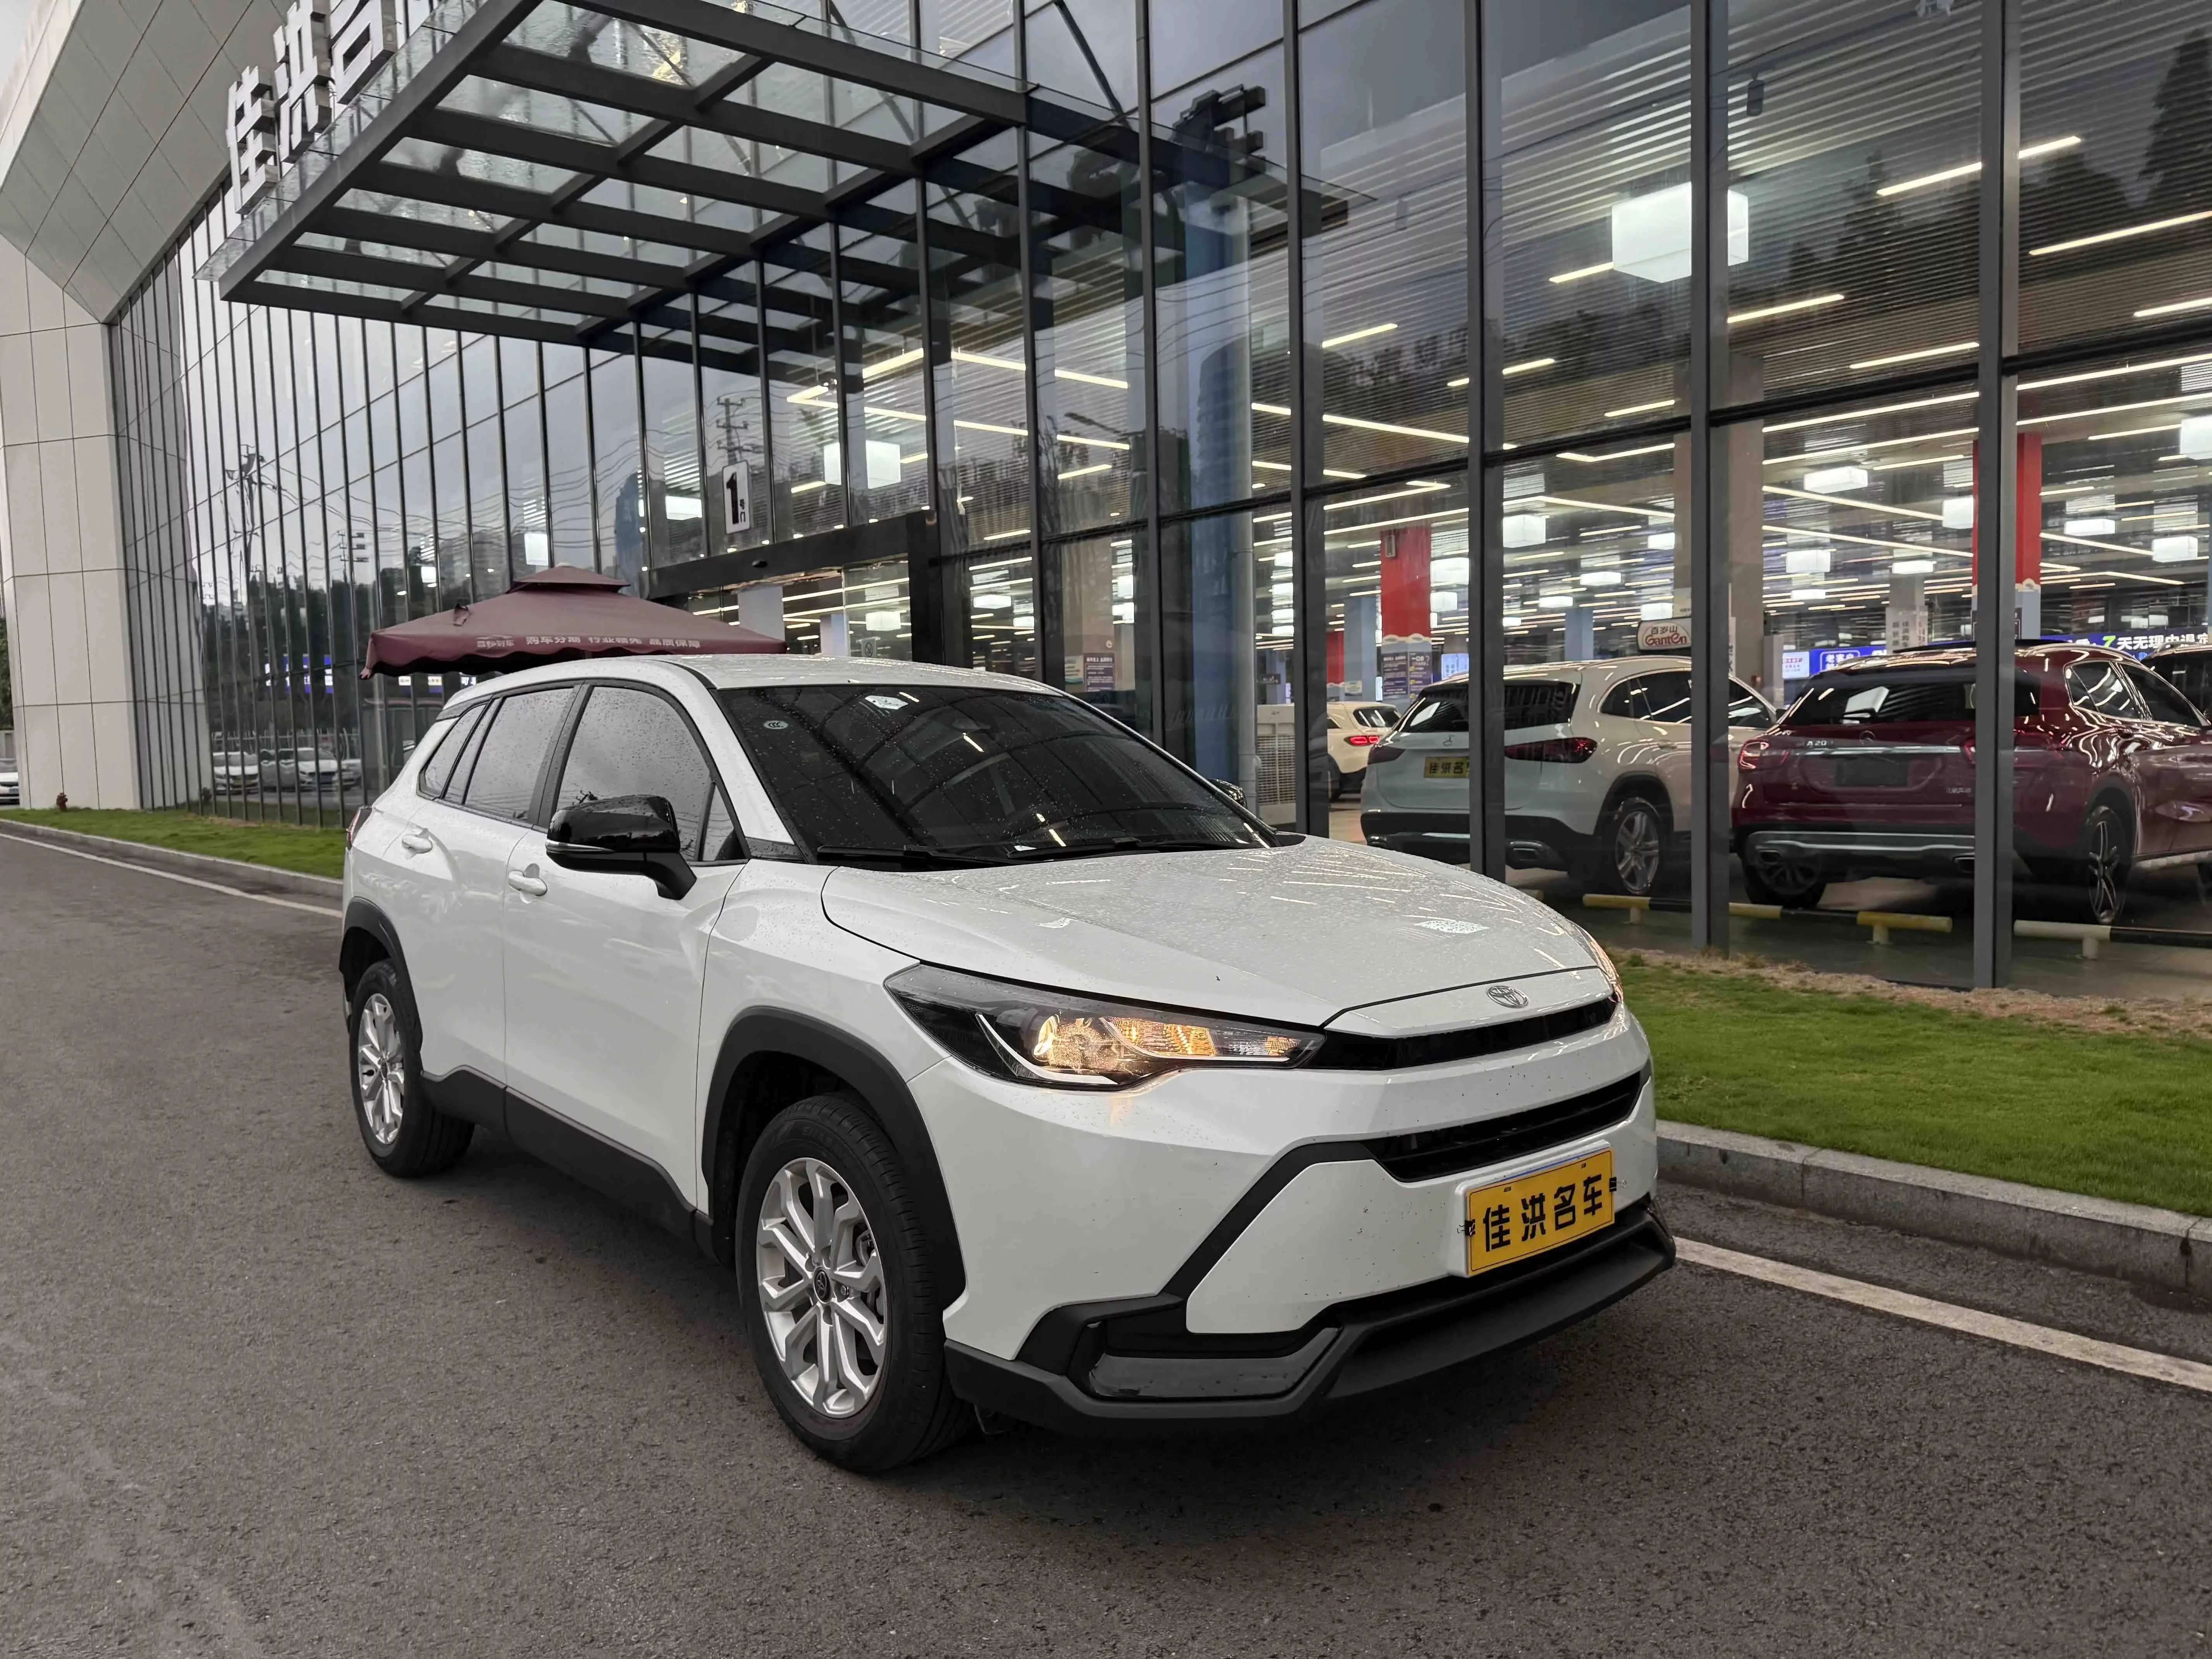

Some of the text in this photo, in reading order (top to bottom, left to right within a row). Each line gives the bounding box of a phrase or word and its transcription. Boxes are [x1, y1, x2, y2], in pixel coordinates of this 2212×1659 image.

[1429, 761, 1470, 774] 佳洪名
[1483, 1174, 1602, 1252] 佳洪名车
